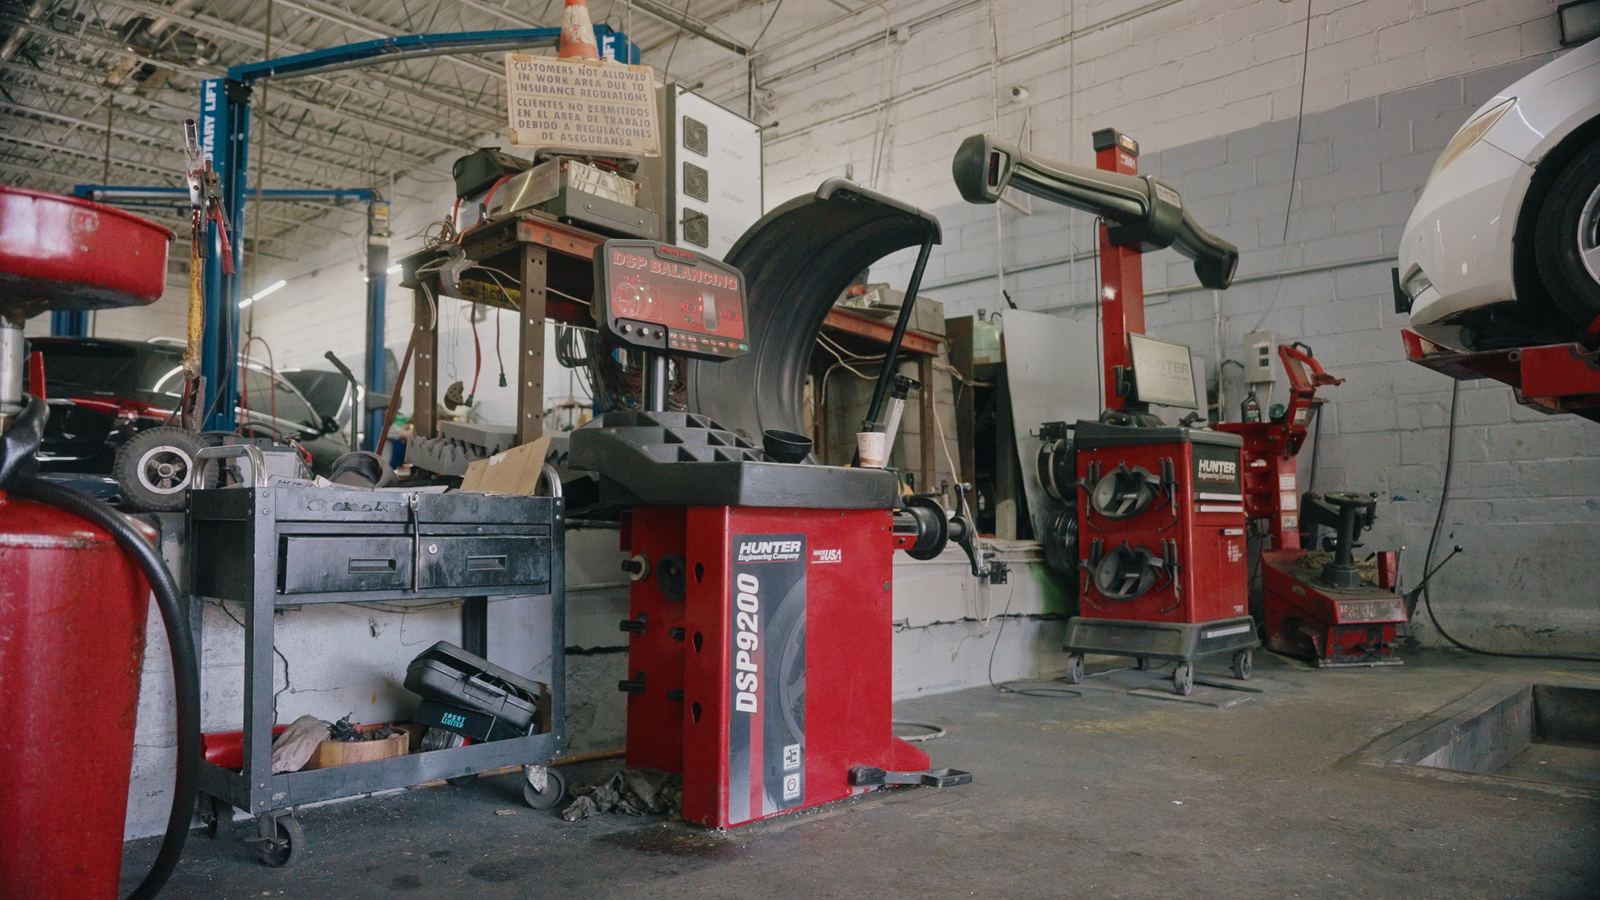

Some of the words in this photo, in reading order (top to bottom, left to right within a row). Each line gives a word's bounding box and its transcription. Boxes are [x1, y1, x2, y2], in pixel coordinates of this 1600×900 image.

[514, 62, 574, 75] CUSTOMERS
[578, 68, 597, 77] NOT
[602, 70, 646, 82] ALLOWED
[518, 73, 530, 81] IN
[536, 74, 569, 85] WORK
[574, 78, 601, 88] AREA
[607, 80, 627, 90] DUE
[632, 82, 644, 92] TO
[204, 80, 217, 111] LIFT
[516, 83, 576, 96] INSURANCE
[580, 89, 648, 102] REGULATIONS
[516, 98, 564, 110] CLIENTES
[568, 102, 584, 112] NO
[588, 104, 650, 117] PERMITIDOS
[517, 109, 531, 118] EN
[537, 110, 548, 119] EL
[554, 111, 581, 121] AREA
[586, 114, 599, 123] DE
[604, 116, 651, 128] TRABAJO
[519, 120, 558, 130] DEBIDO
[563, 122, 571, 131] A
[576, 123, 652, 138] REGULACIONES
[541, 131, 554, 140] DE
[560, 133, 632, 147] ASEGURANSA
[612, 251, 648, 270] DSP
[650, 260, 738, 291] BALANCING
[1198, 459, 1236, 474] HUNTER
[738, 553, 772, 562] Engineering
[772, 552, 800, 561] Company
[739, 541, 801, 554] HUNTER
[824, 548, 842, 561] USA
[736, 572, 759, 713] DSP9200
